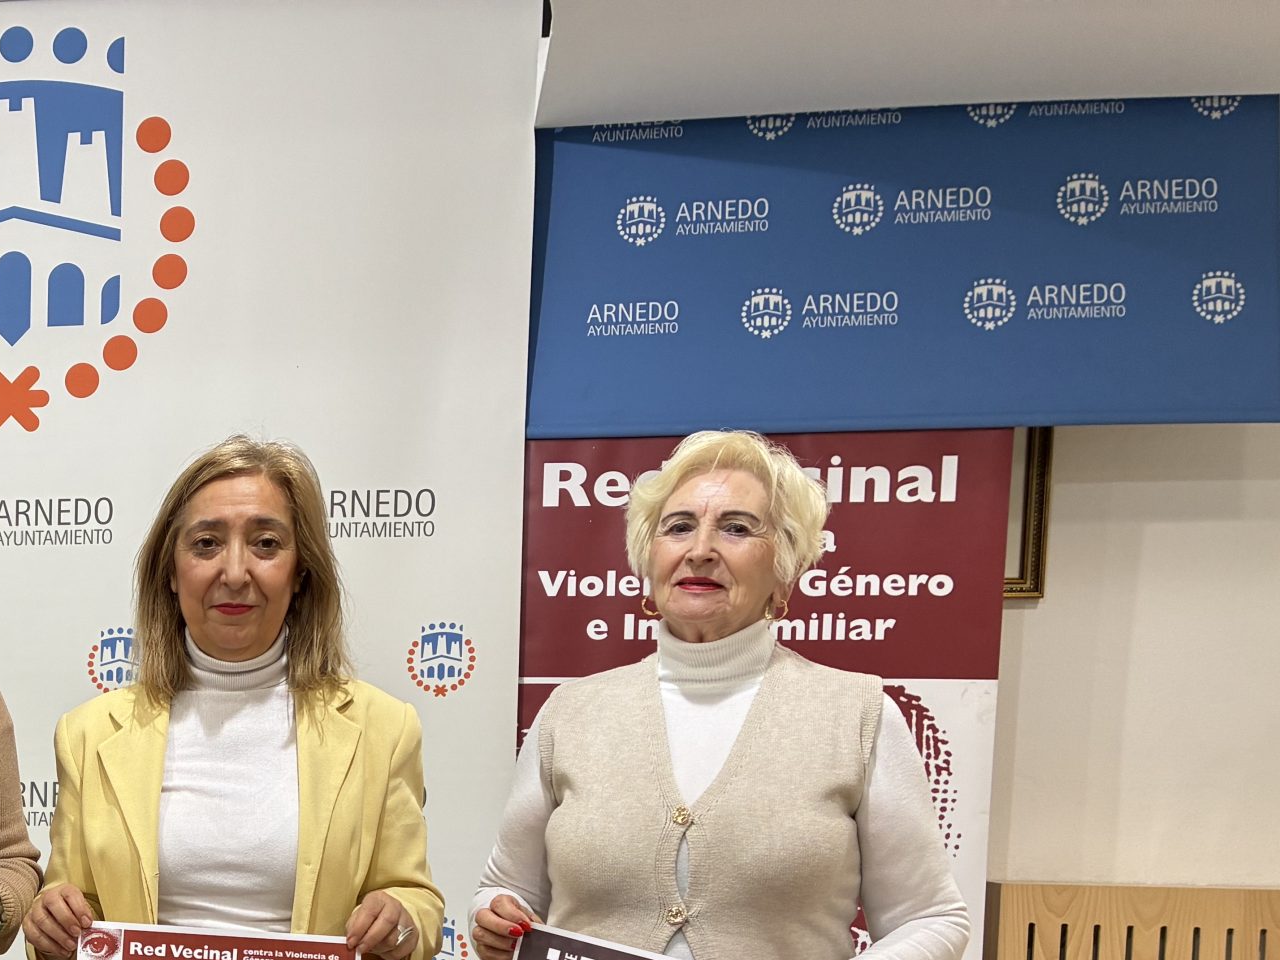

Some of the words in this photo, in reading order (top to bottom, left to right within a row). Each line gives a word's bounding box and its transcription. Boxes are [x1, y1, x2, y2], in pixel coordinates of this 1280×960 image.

[807, 113, 901, 128] AYUNTAMIENTO
[593, 126, 683, 142] AYUNTAMIENTO
[1120, 178, 1217, 200] ARNEDO
[894, 187, 991, 210] ARNEDO
[1120, 200, 1217, 214] AYUNTAMIENTO
[676, 198, 768, 223] ARNEDO
[895, 209, 991, 224] AYUNTAMIENTO
[676, 220, 768, 235] AYUNTAMIENTO
[802, 292, 898, 314] ARNEDO
[1027, 283, 1125, 308] ARNEDO
[587, 301, 678, 325] ARNEDO
[803, 313, 897, 327] AYUNTAMIENTO
[1028, 305, 1125, 319] AYUNTAMIENTO
[588, 322, 678, 336] AYUNTAMIENTO
[330, 489, 435, 517] RNEDO
[329, 521, 434, 538] UNTAMIENTO
[799, 567, 954, 597] Género
[129, 941, 165, 957] Red
[169, 943, 237, 960] Vecinal
[243, 948, 272, 957] contra
[284, 950, 326, 960] Violencia
[328, 953, 339, 960] de
